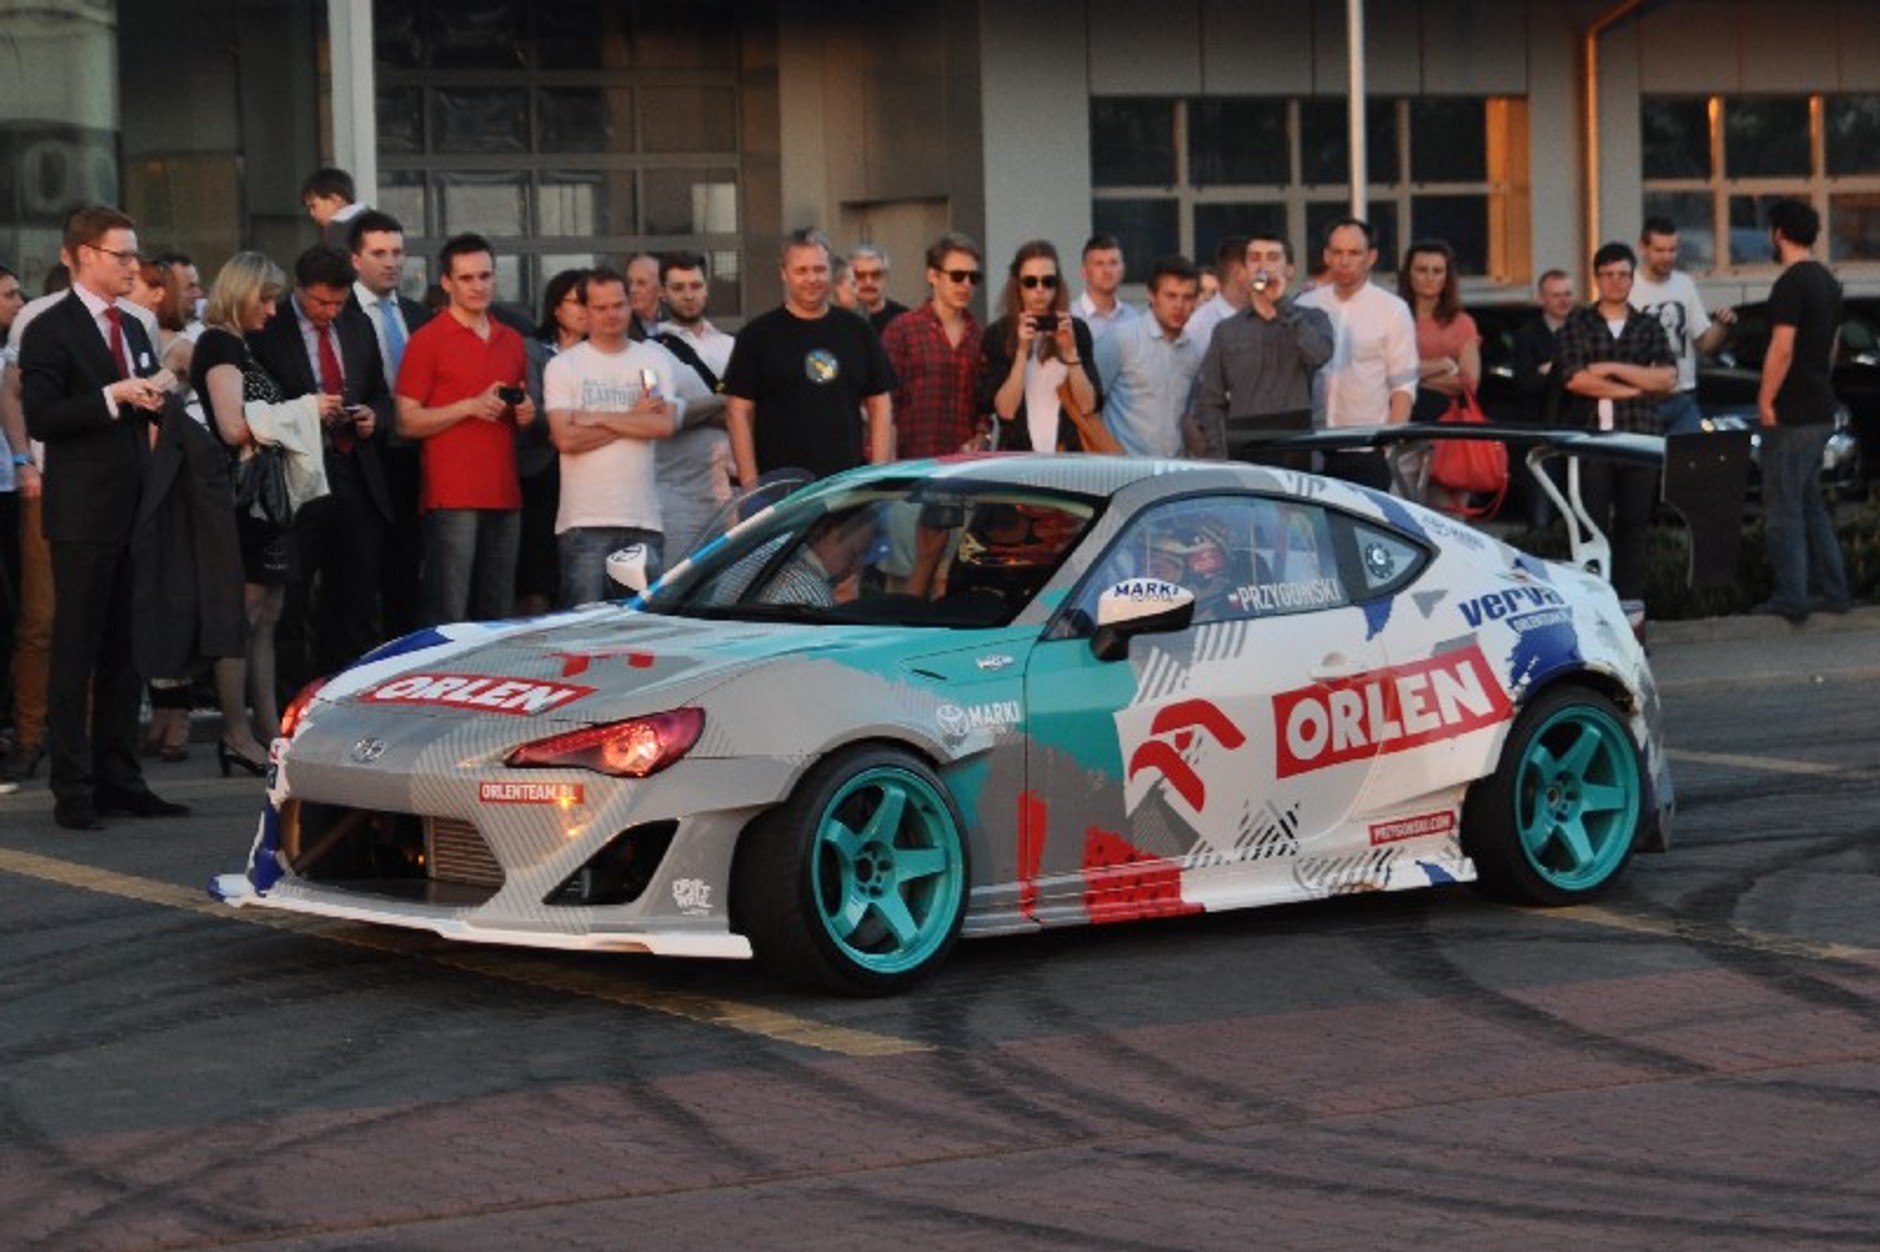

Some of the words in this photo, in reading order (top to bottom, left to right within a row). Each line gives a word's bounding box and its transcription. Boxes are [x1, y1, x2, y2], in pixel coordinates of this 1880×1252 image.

[1114, 582, 1179, 597] MARKI
[1458, 586, 1565, 628] verva
[374, 676, 574, 711] ORLEN
[1285, 660, 1493, 761] ORLEN
[967, 700, 1021, 727] MARKI
